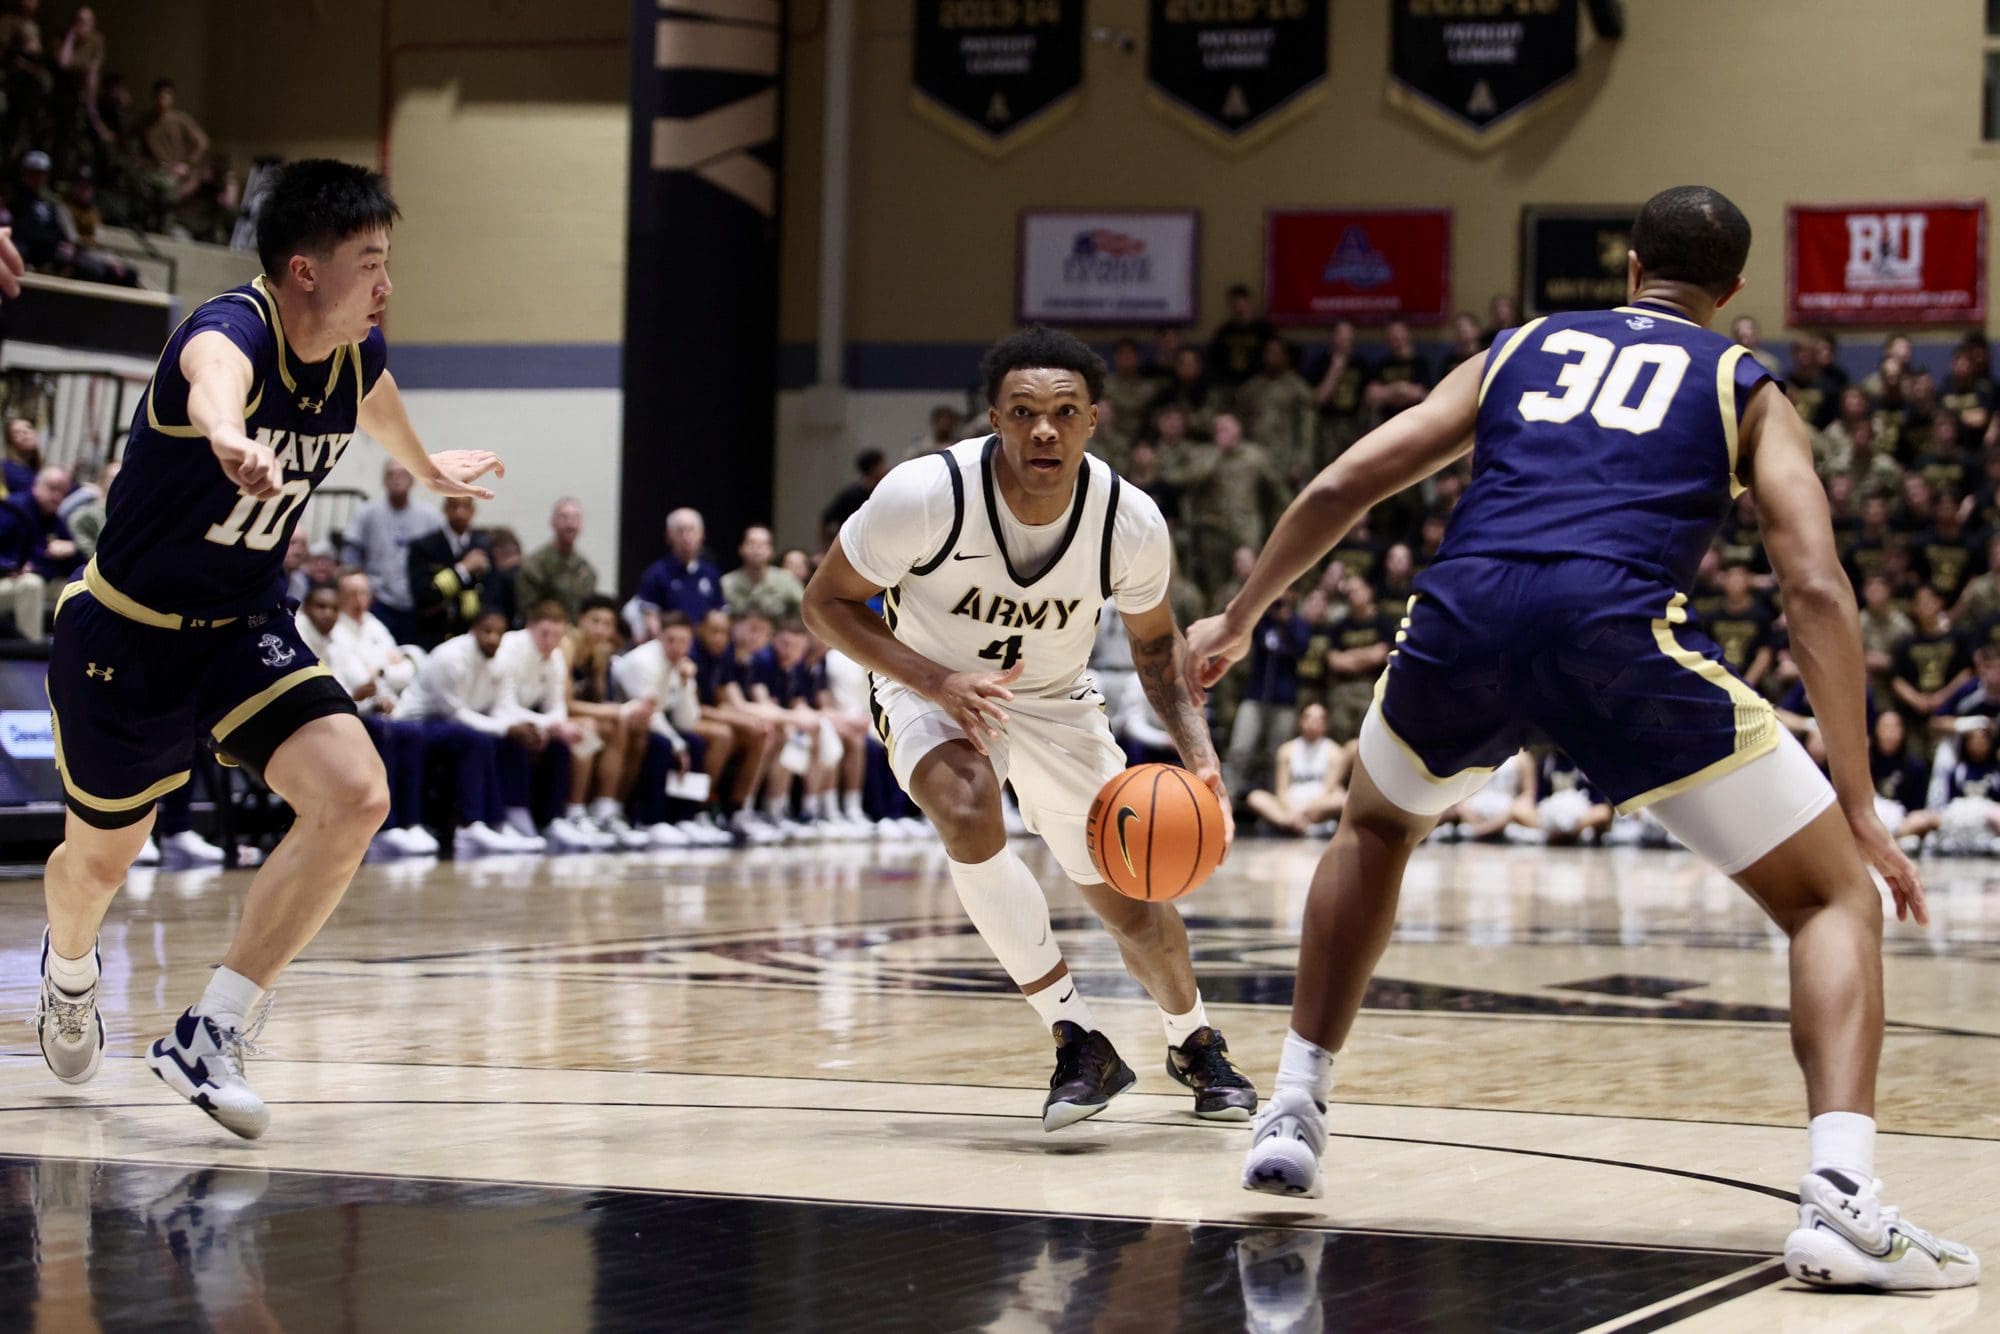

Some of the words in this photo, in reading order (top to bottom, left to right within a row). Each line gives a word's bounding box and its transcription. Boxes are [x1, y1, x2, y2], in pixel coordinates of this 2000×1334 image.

[1845, 213, 1929, 276] BU
[1517, 328, 1691, 435] 30
[203, 478, 311, 551] 10
[949, 586, 1082, 629] ARMY
[977, 635, 1023, 671] 4
